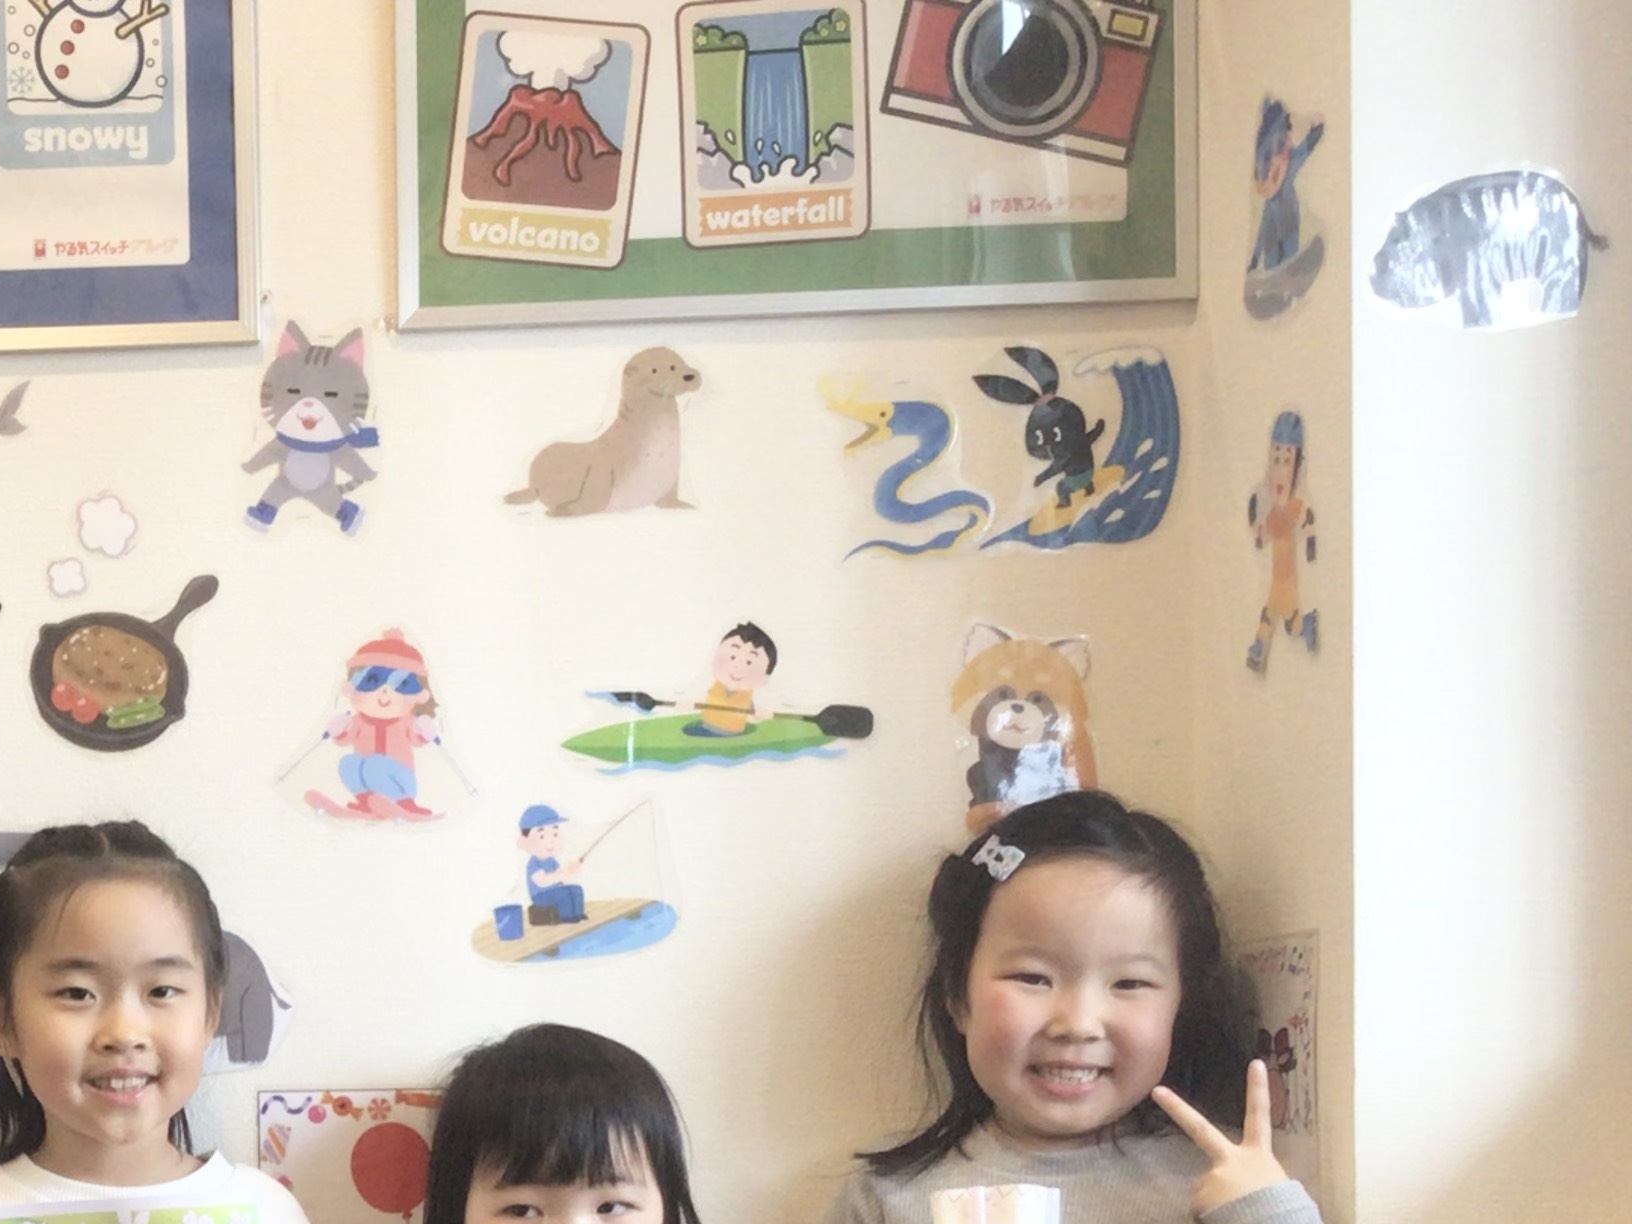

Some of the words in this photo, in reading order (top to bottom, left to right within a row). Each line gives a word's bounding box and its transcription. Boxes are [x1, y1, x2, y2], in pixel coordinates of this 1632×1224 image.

[23, 121, 150, 160] snowy
[705, 192, 846, 234] waterfall
[467, 216, 602, 254] volcano
